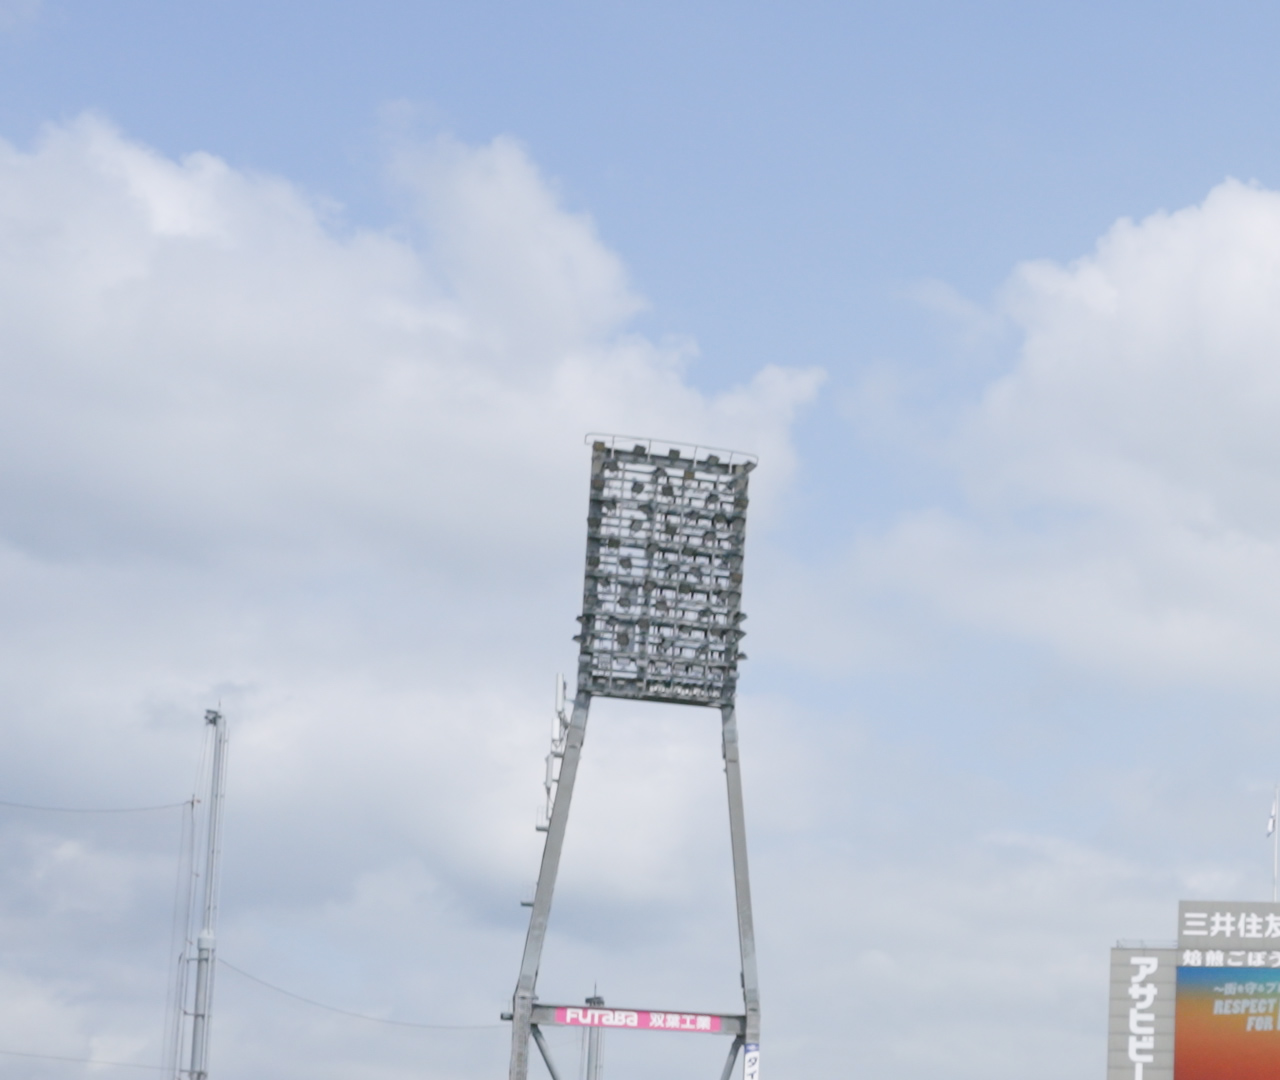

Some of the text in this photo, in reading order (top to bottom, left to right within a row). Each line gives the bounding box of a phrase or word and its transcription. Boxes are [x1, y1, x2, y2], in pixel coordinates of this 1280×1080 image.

[1213, 999, 1277, 1015] RESPECT
[650, 1013, 711, 1030] 双葉工業
[1246, 1016, 1274, 1032] FOR
